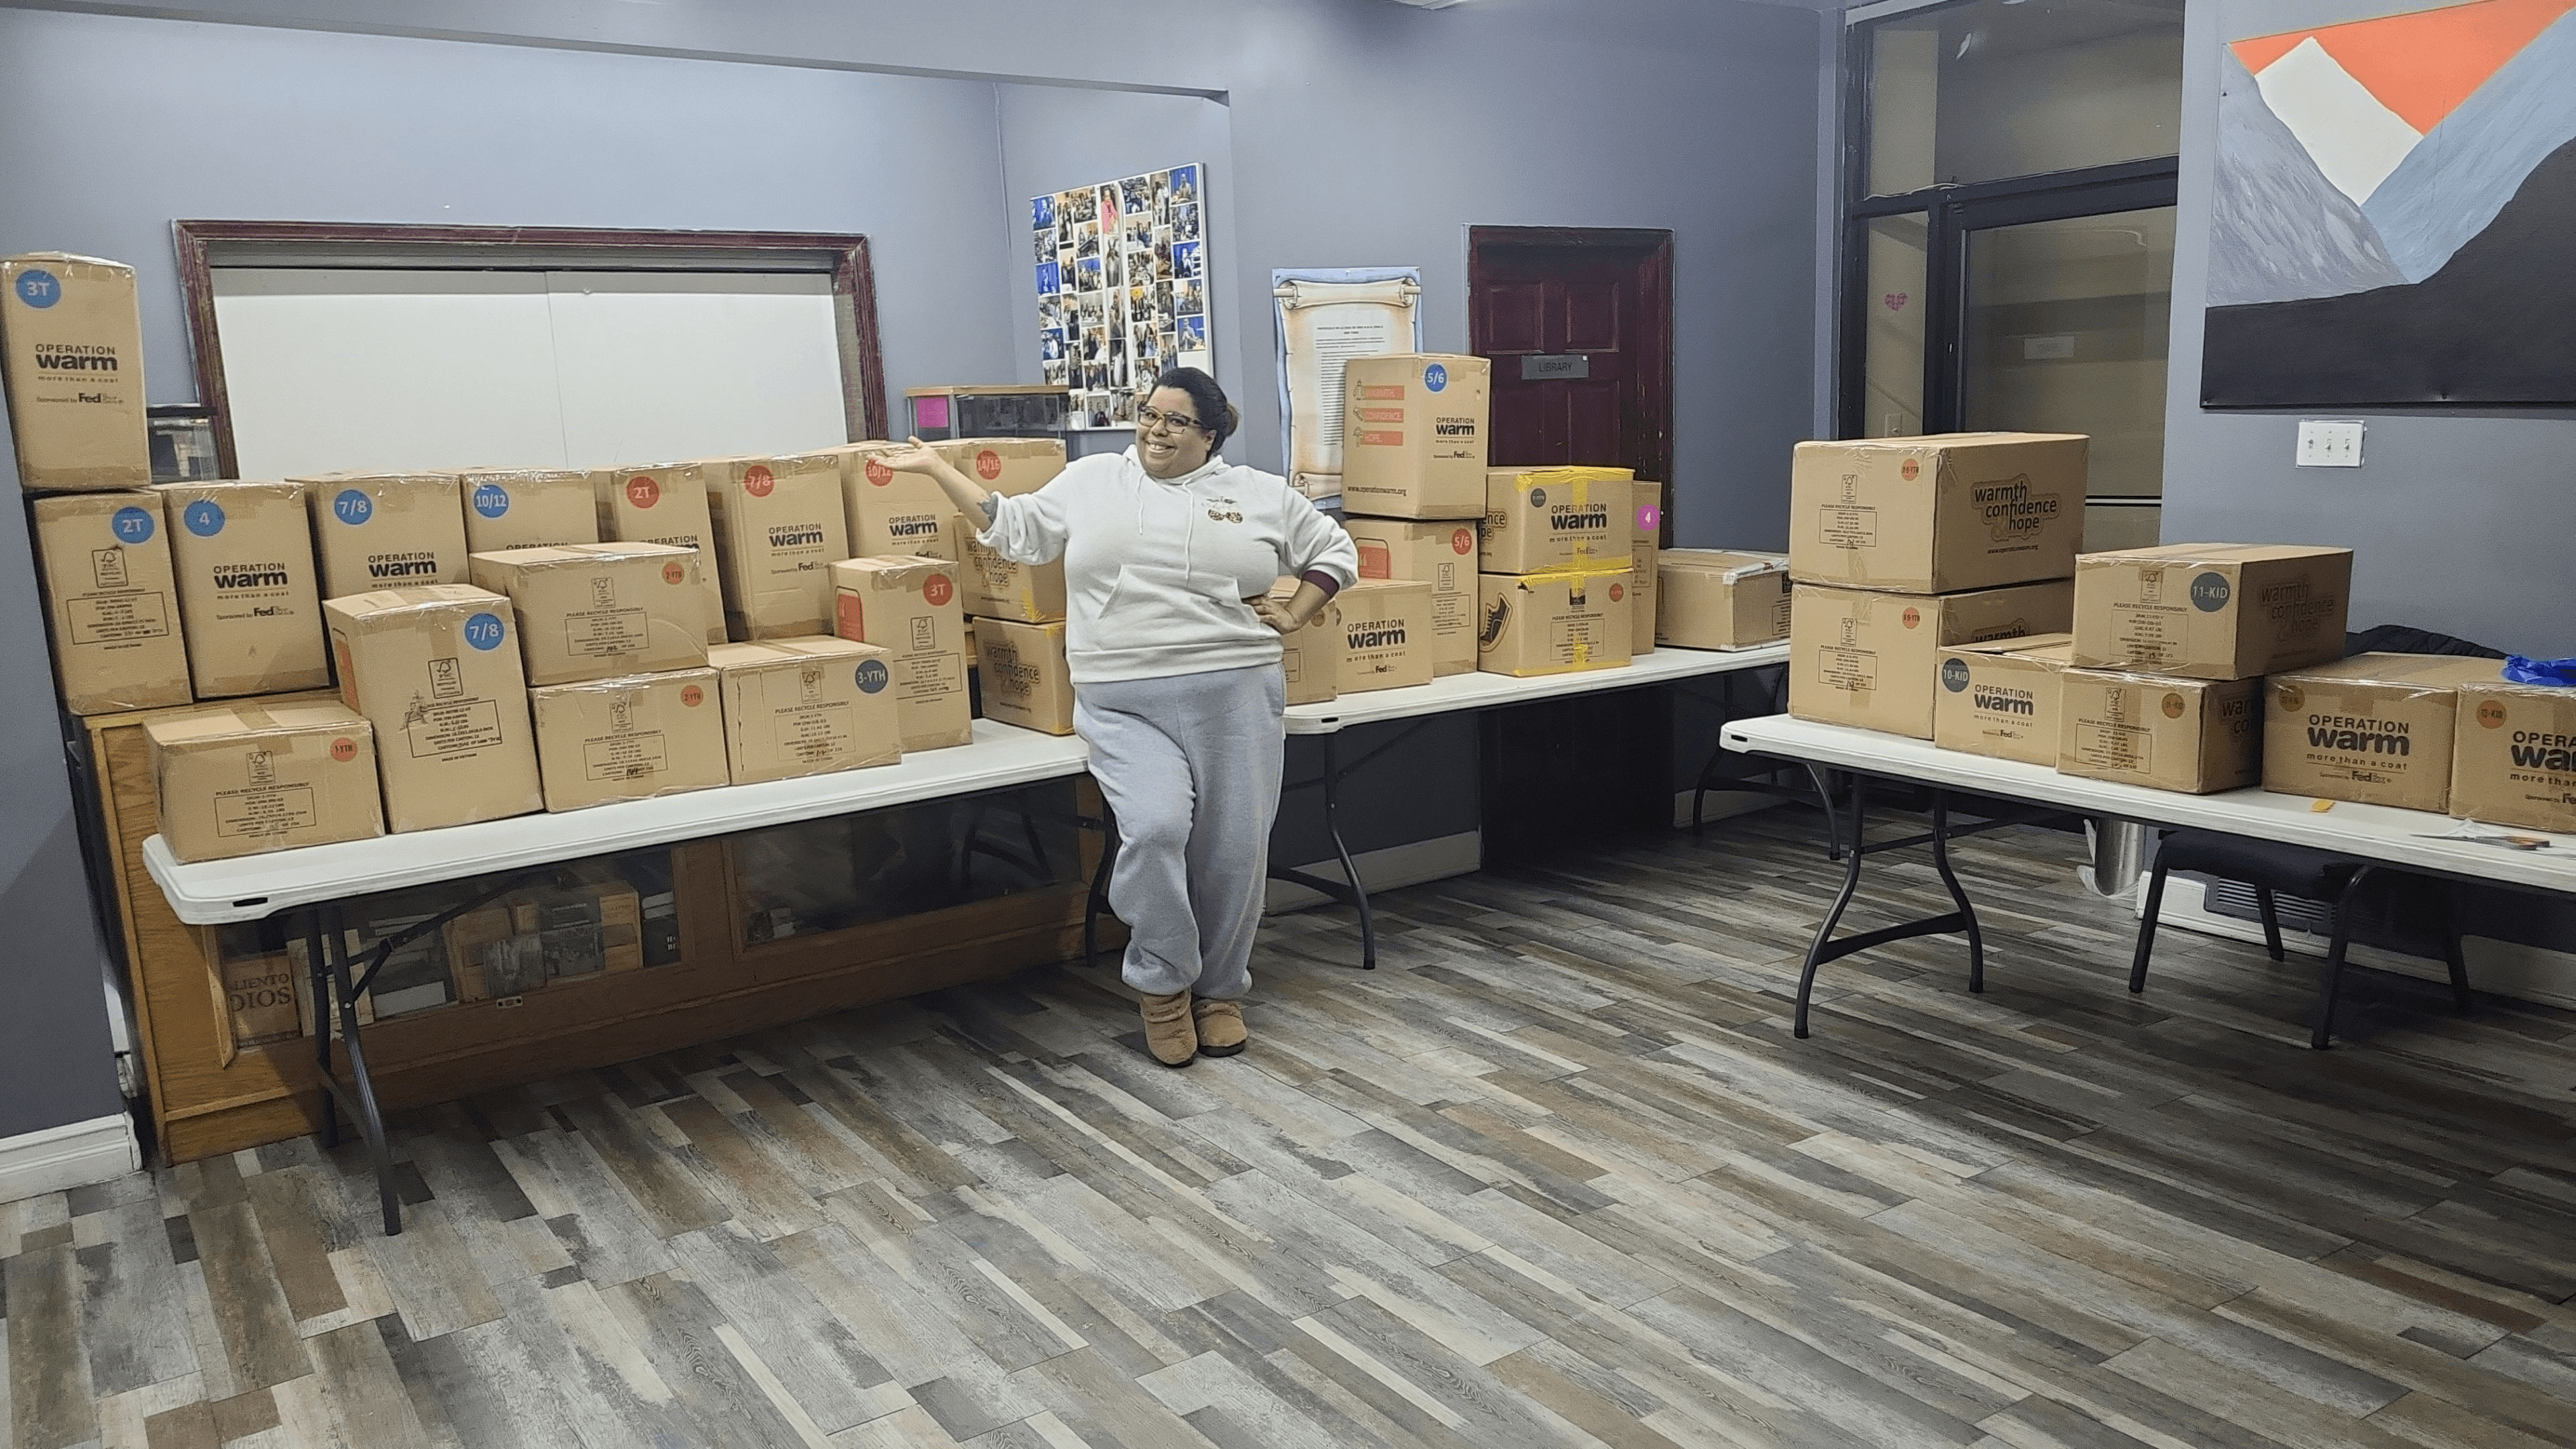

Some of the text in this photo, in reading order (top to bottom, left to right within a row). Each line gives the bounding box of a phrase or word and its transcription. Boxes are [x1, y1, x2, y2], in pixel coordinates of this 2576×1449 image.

[27, 281, 50, 296] 3T
[36, 343, 115, 356] OPERATION
[36, 354, 118, 371] warm
[1539, 362, 1572, 372] LIBRARY
[1427, 372, 1444, 384] 5/6
[1436, 424, 1474, 435] warm
[749, 473, 771, 489] 7/8
[634, 486, 649, 498] 2T
[1975, 480, 2027, 503] warmth
[339, 499, 368, 516] 7/8
[476, 494, 506, 509] 10/12
[1551, 503, 1607, 514] OPERATION
[1986, 498, 2057, 519] confidence
[199, 512, 210, 525] 4
[889, 514, 936, 524] OPERATION
[1551, 513, 1607, 530] warm
[1645, 511, 1651, 523] 4
[123, 519, 143, 533] 2T
[769, 523, 821, 534] OPERATION
[889, 522, 938, 537] warm
[2009, 517, 2039, 533] hope
[639, 534, 698, 545] PERATION
[769, 531, 823, 547] warm
[1454, 535, 1470, 548] 5/6
[368, 552, 434, 563] OPERATION
[214, 562, 285, 574] OPERATION
[368, 561, 437, 577] warm
[214, 572, 288, 588] warm
[989, 571, 1008, 584] hope
[930, 584, 946, 596] 3T
[2192, 585, 2227, 599] 11-KID
[470, 623, 499, 641] 7/8
[1348, 619, 1404, 633] OPERATION
[1348, 629, 1405, 649] warm
[987, 645, 1018, 661] warmth
[857, 669, 886, 684] 3-YTH
[994, 663, 1039, 680] confidence
[1943, 669, 1968, 682] 10-KID
[1010, 678, 1029, 694] hope
[1975, 684, 2033, 700] OPERATION
[816, 700, 849, 708] RESPONSIBLY
[1974, 694, 2033, 716] warm
[2309, 714, 2409, 734] OPERATION
[2308, 727, 2410, 756] warm
[2513, 731, 2576, 748] OPERA
[2306, 753, 2336, 761] more
[2339, 756, 2366, 765] than
[2381, 761, 2407, 770] coat
[2351, 770, 2386, 784] FedEx
[2510, 773, 2544, 783] more
[229, 987, 290, 1012] DIOS
